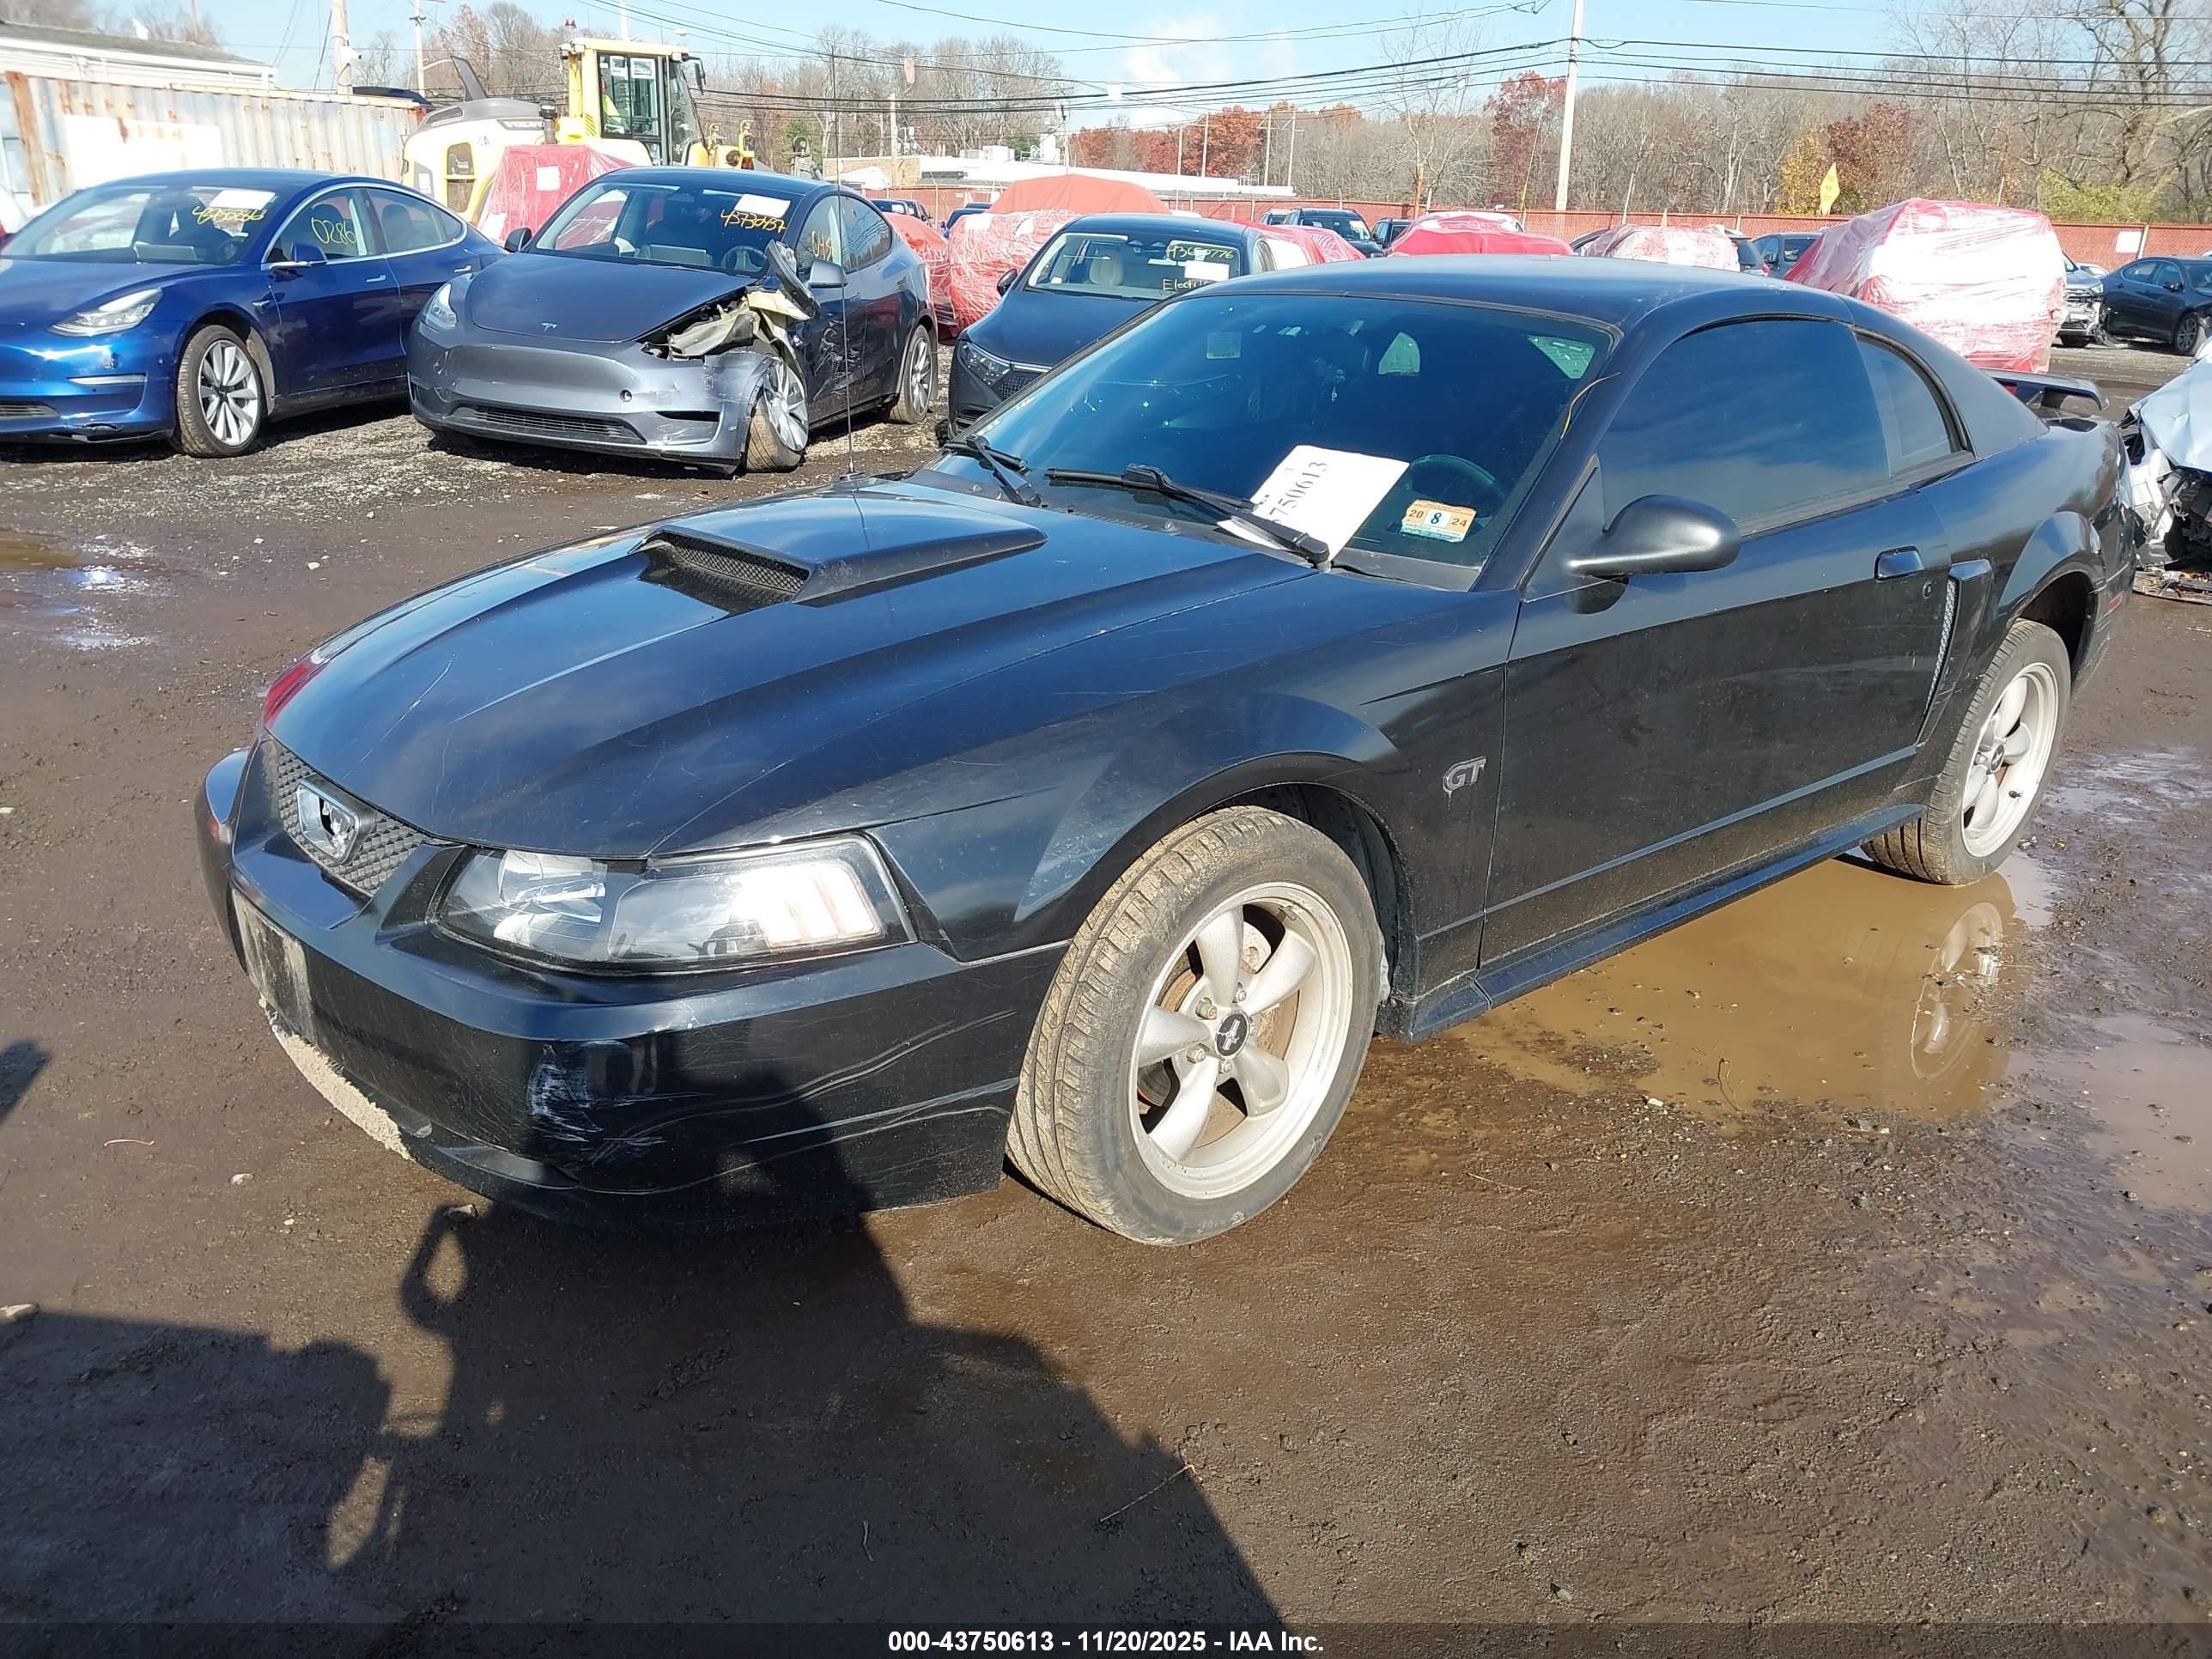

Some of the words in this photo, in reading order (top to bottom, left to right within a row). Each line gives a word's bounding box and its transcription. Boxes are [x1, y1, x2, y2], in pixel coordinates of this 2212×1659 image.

[311, 216, 356, 245] 0286
[1168, 245, 1234, 258] 4360776
[1408, 509, 1425, 519] 20
[1431, 512, 1443, 525] 8
[1450, 517, 1468, 527] 24
[1443, 756, 1486, 792] GT
